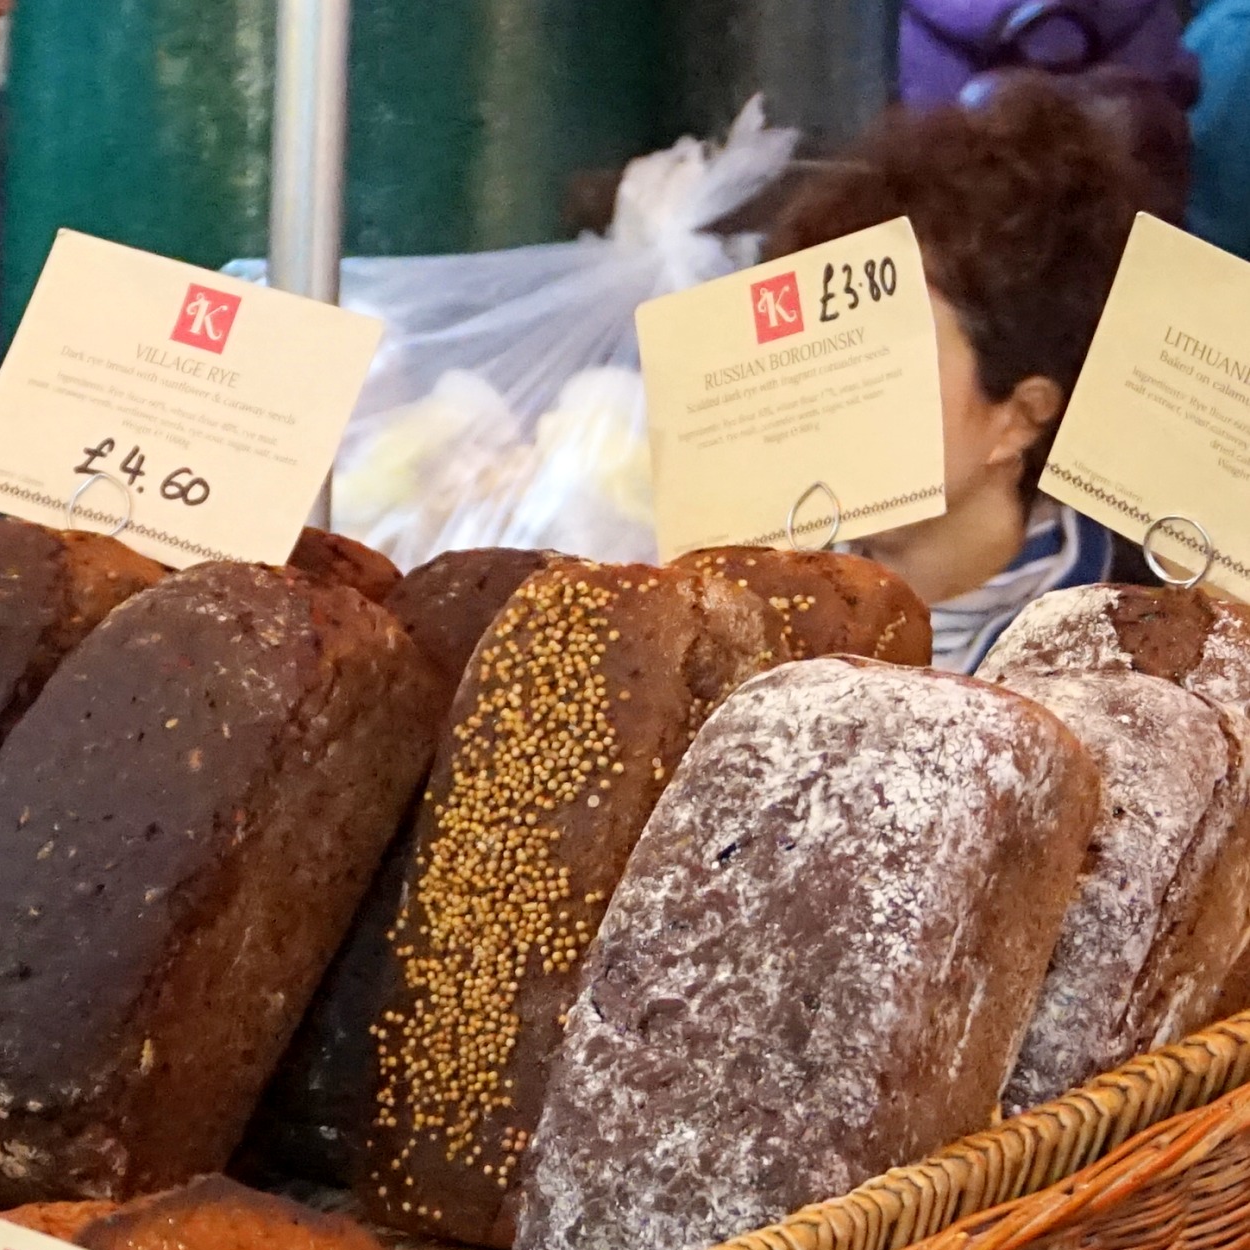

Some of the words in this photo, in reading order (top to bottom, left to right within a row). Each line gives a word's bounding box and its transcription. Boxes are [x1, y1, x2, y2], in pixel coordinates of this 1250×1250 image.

[755, 283, 799, 330] K
[818, 256, 898, 323] £3.80
[184, 289, 229, 342] K
[132, 343, 207, 378] VILLAGE
[205, 364, 241, 389] RYE
[703, 356, 766, 390] RUSSIAN
[768, 325, 866, 371] BORODINSKY
[1158, 348, 1195, 376] Baked
[1194, 370, 1211, 385] on
[135, 367, 159, 383] with
[158, 374, 211, 400] sunflower
[1123, 378, 1146, 394] malt
[1188, 394, 1210, 413] Rye
[1208, 406, 1233, 424] flour
[73, 437, 211, 507] £4.60
